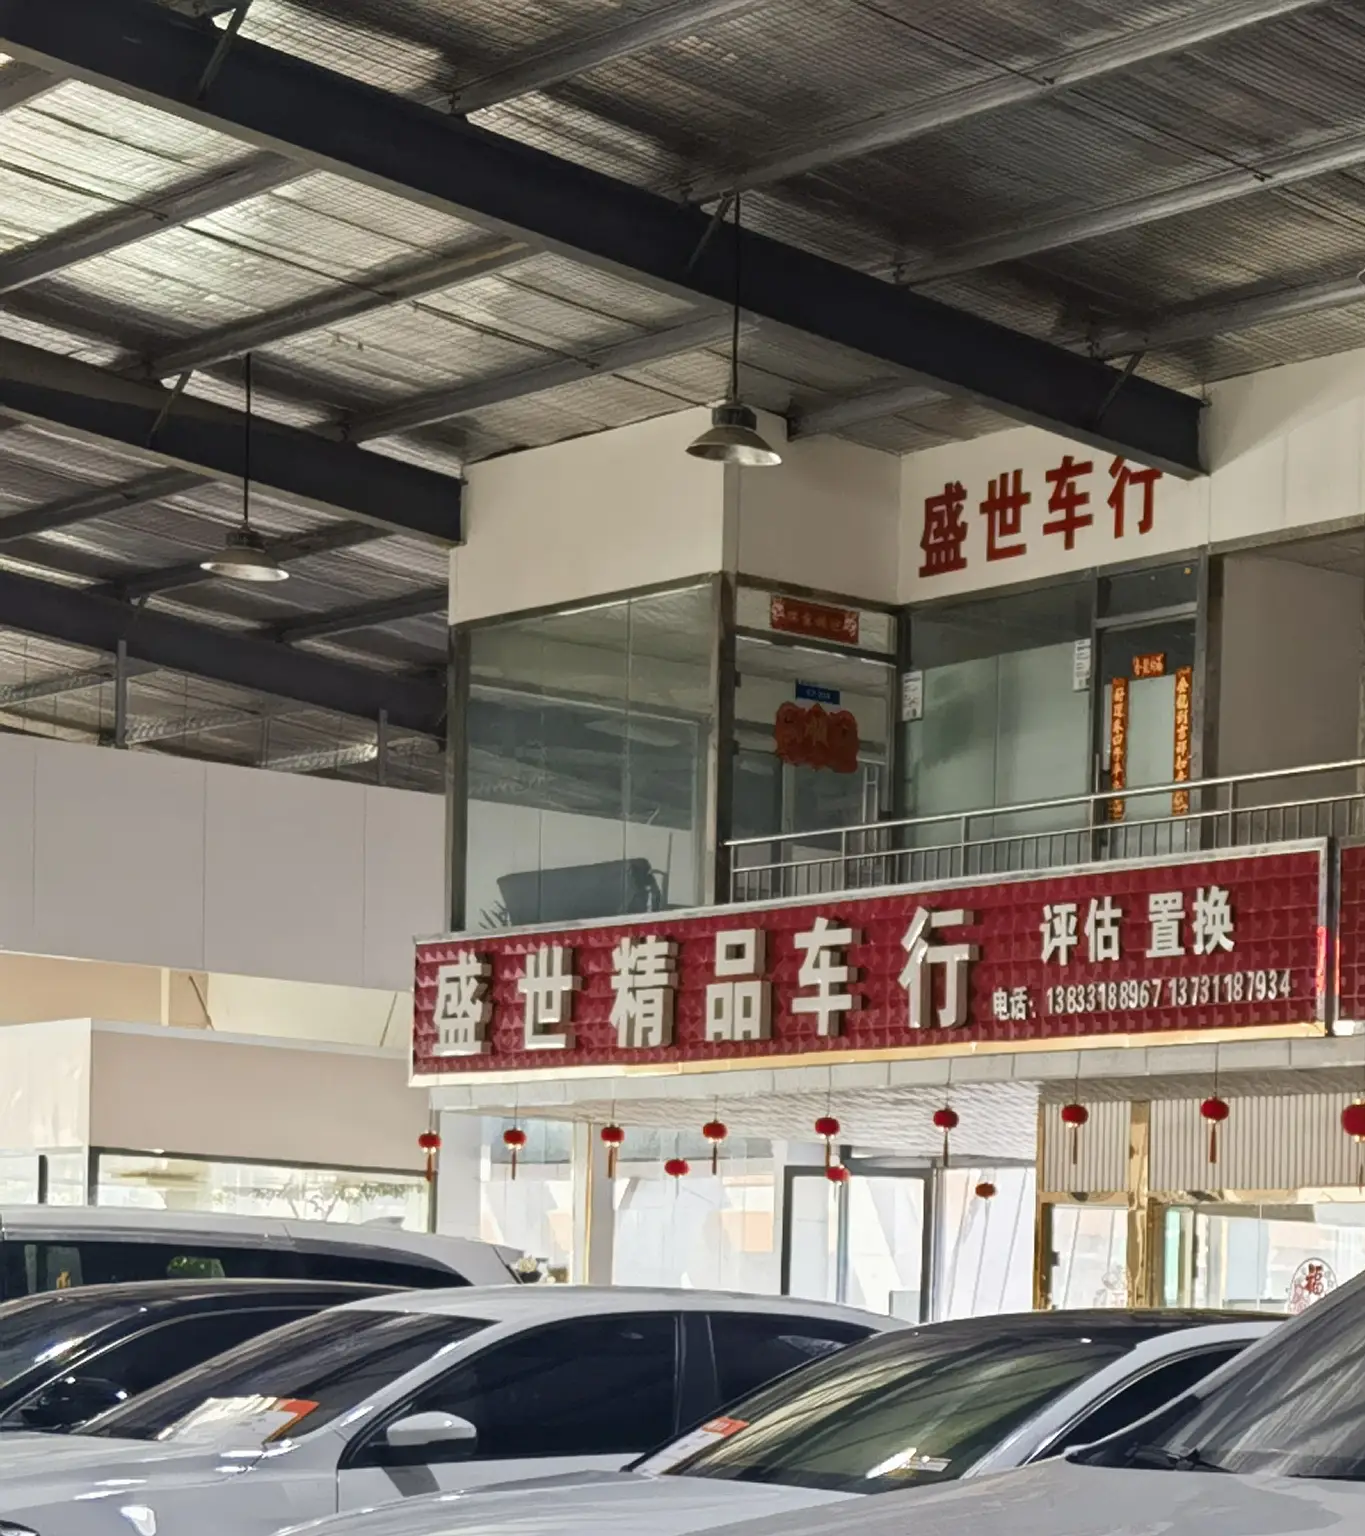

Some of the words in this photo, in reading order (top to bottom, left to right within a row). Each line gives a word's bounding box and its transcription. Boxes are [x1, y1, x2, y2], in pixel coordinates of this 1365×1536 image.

[919, 455, 1163, 578] 盛世车行
[1039, 896, 1123, 966] 评估
[1146, 885, 1236, 960] 置换
[433, 906, 979, 1056] 盛世精品车行
[992, 986, 1037, 1021] 电话：
[1046, 978, 1163, 1015] 13833188967
[1168, 969, 1292, 1008] 13731187934
